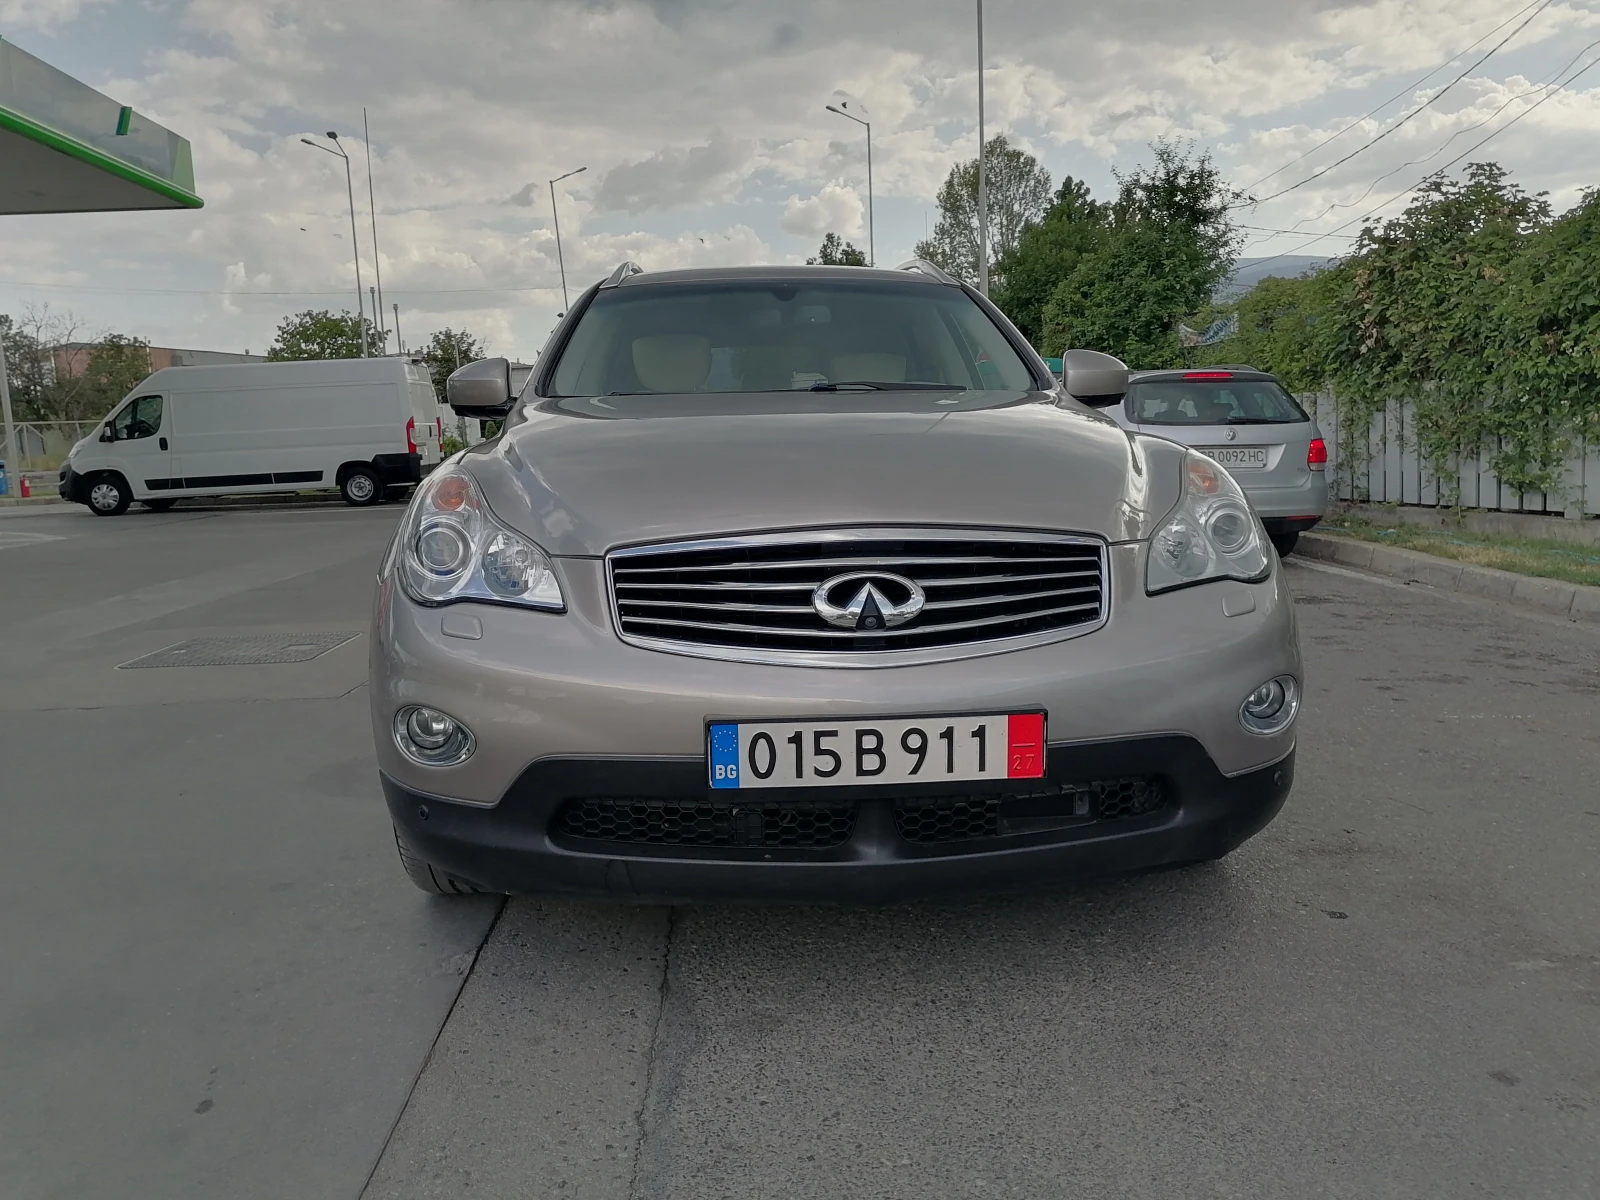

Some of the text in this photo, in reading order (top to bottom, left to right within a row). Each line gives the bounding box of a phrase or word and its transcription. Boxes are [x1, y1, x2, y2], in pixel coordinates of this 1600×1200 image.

[1218, 450, 1246, 462] 0092
[1248, 450, 1264, 462] HC
[1012, 754, 1035, 771] 27
[715, 764, 738, 780] BG
